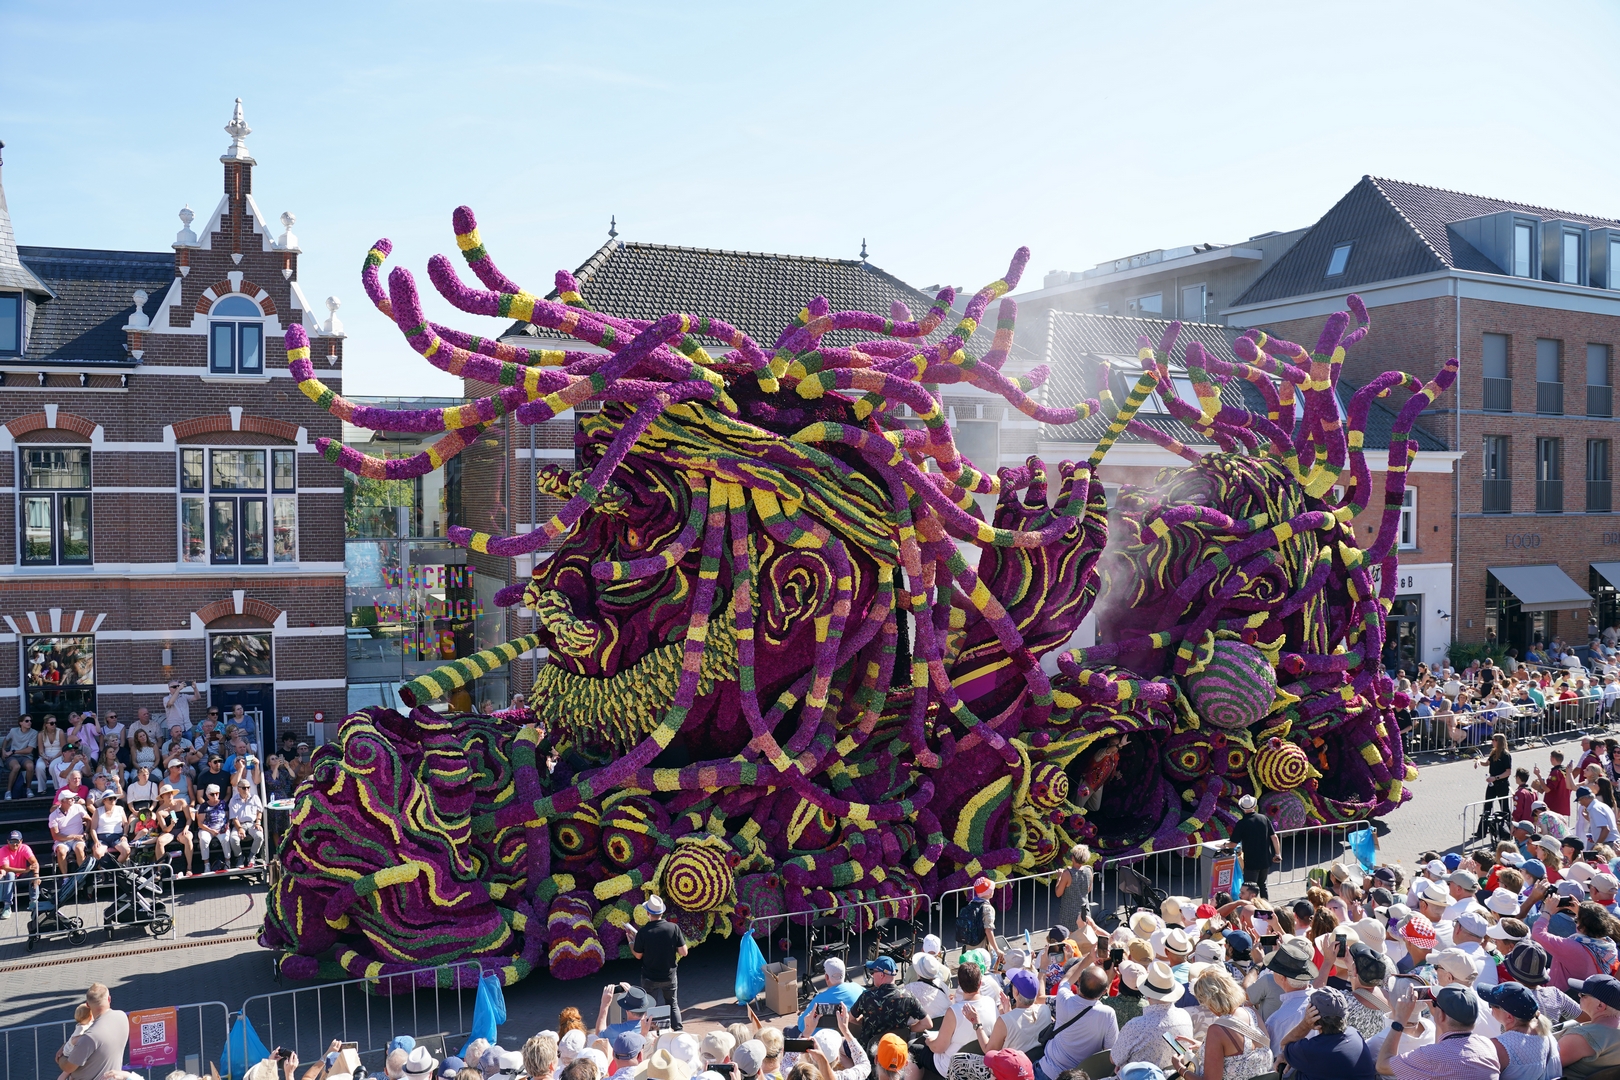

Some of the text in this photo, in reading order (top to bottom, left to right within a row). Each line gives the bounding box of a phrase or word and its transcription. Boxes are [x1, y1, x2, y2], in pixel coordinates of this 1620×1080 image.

[1505, 532, 1542, 549] FOOD
[381, 565, 477, 590] VINCENT
[373, 597, 485, 623] VAN GOGH
[403, 631, 456, 655] HUIS
